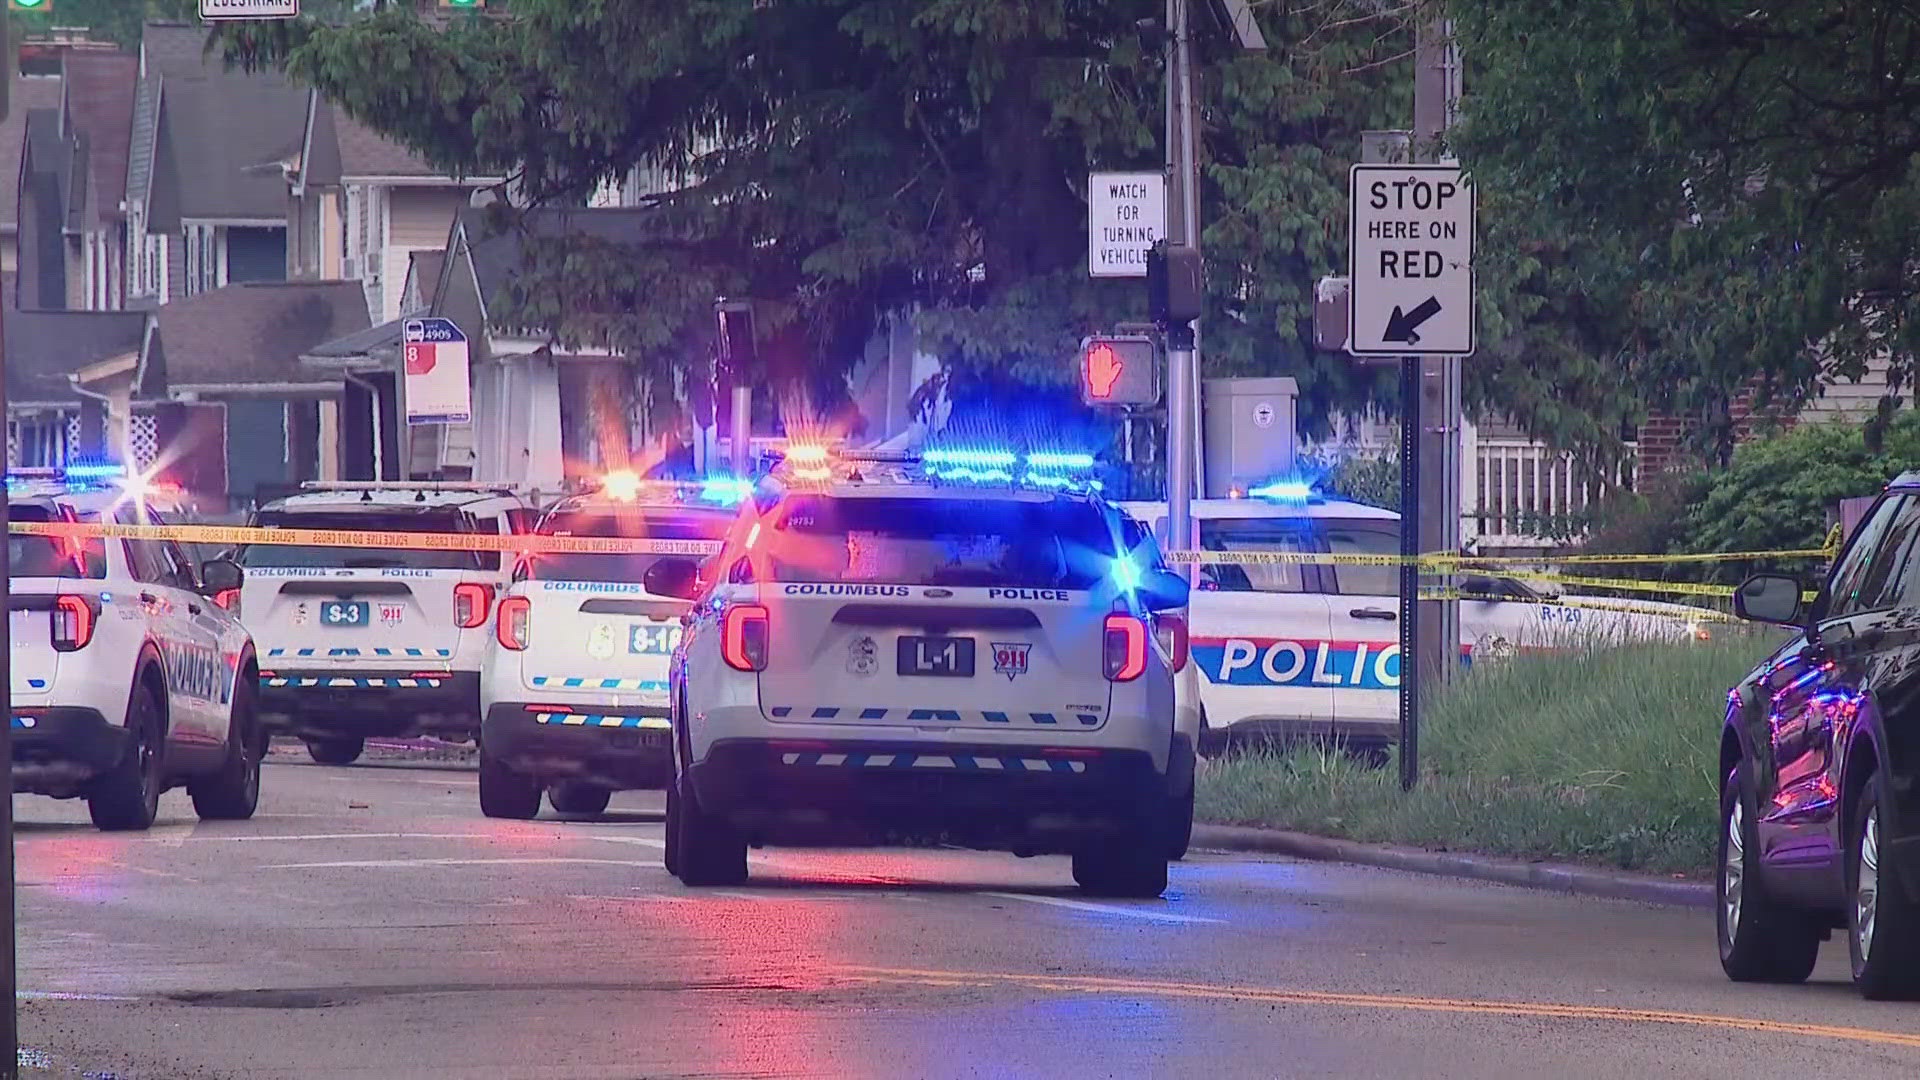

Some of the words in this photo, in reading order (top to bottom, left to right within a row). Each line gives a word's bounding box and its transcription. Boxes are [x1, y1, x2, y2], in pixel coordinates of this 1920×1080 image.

[1109, 184, 1147, 199] WATCH
[1370, 181, 1456, 210] STOP
[1117, 205, 1139, 220] FOR
[1103, 227, 1154, 242] TURNING
[1368, 221, 1420, 239] HERE
[1429, 221, 1456, 239] ON
[1101, 249, 1148, 264] VEHICLE
[1380, 250, 1443, 278] RED
[407, 347, 419, 362] 8
[250, 568, 327, 577] COLUMBUS
[381, 569, 433, 577] POLICE
[543, 581, 640, 593] COLUMBUS
[785, 584, 910, 597] COLUMBUS
[988, 589, 1070, 602] POLICE
[329, 605, 360, 623] S-3
[382, 609, 402, 620] 911
[1542, 606, 1581, 622] R-120
[916, 642, 957, 670] L-1
[1218, 638, 1400, 687] POLIC
[169, 644, 213, 699] POLICE
